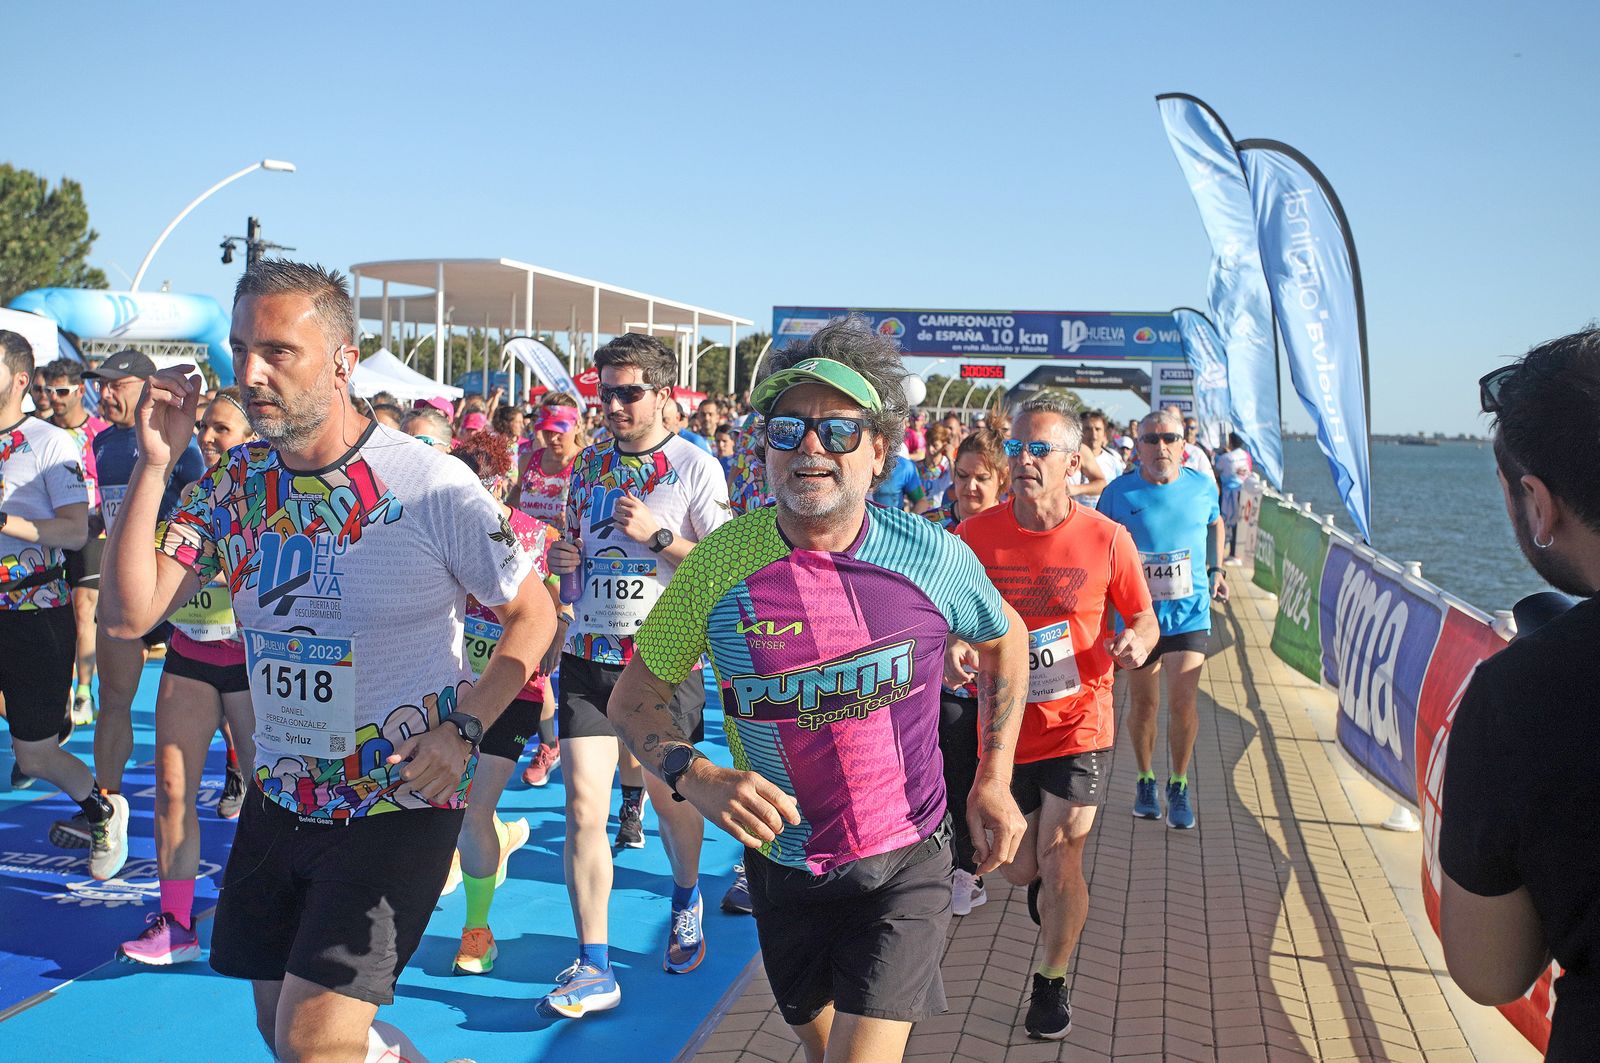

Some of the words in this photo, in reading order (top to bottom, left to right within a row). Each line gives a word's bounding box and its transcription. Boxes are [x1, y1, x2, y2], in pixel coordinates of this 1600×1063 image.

[918, 315, 1015, 330] CAMPEONATO
[917, 331, 933, 342] de
[935, 329, 984, 343] ESPAÑA
[992, 329, 1014, 347] 10
[1019, 328, 1049, 347] km
[1061, 320, 1087, 353] 10
[1087, 327, 1126, 342] HUELVA
[980, 344, 1013, 353] Absoluto
[1021, 345, 1048, 353] Master
[1145, 564, 1181, 579] 1441
[592, 578, 644, 600] 1182
[181, 591, 212, 609] 40
[309, 601, 329, 612] PUERTA
[330, 602, 342, 613] DEL
[294, 608, 342, 621] DESCUBRIMIENTO
[1041, 628, 1062, 644] 2023
[264, 641, 286, 653] HUELVA
[308, 644, 343, 661] 2023
[750, 639, 786, 650] VEYSER
[1029, 648, 1054, 671] 90
[261, 663, 334, 704] 1518
[281, 706, 305, 718] DANIEL
[266, 713, 289, 725] PEREZA
[288, 719, 328, 732] GONZÁLEZ
